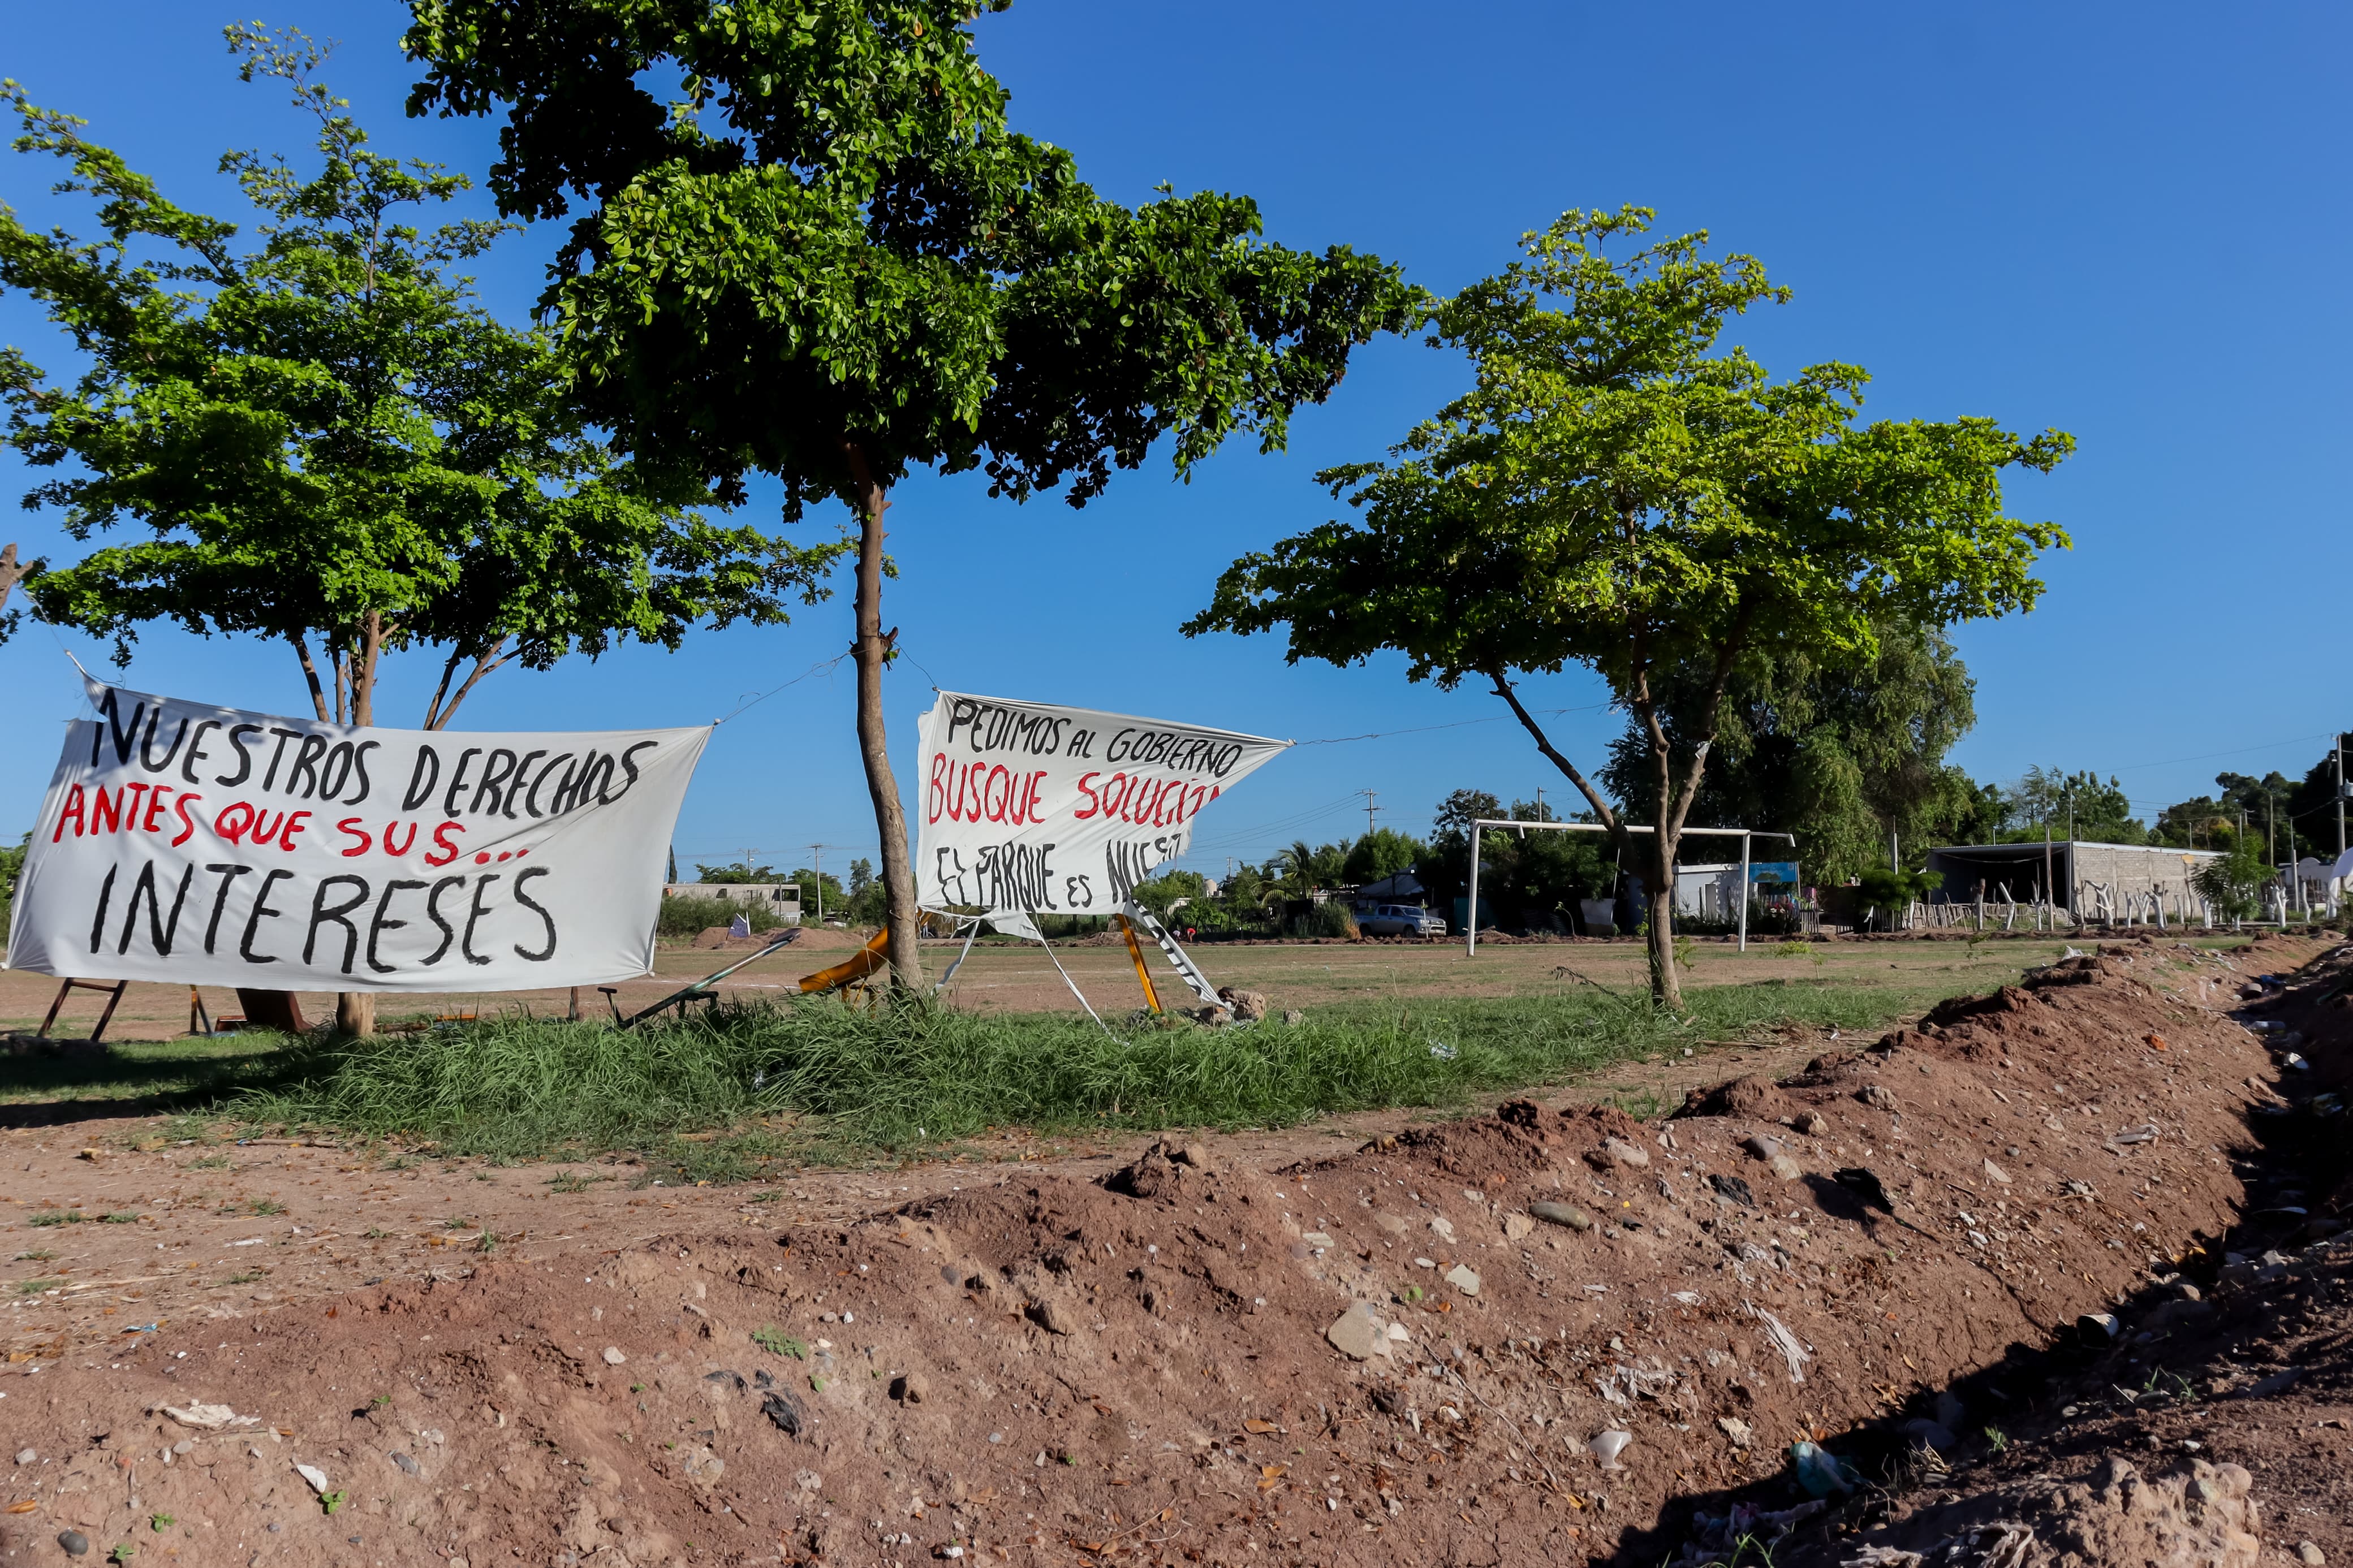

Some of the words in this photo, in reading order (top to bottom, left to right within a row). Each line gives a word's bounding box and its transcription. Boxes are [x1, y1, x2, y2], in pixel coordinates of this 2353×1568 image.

[91, 688, 381, 805] NUESTROS
[402, 741, 658, 819] DERECHOS
[948, 699, 1072, 754] PEDIMOS
[1067, 729, 1092, 758] AL
[1107, 728, 1243, 777] GOBIERNO
[53, 783, 203, 847] ANTES
[214, 801, 312, 852] QUE
[929, 753, 1048, 826] BUSQUE
[937, 846, 971, 905] EL
[975, 840, 1057, 913] PARQUE
[1066, 874, 1093, 908] ES
[90, 859, 557, 974] INTERESES
